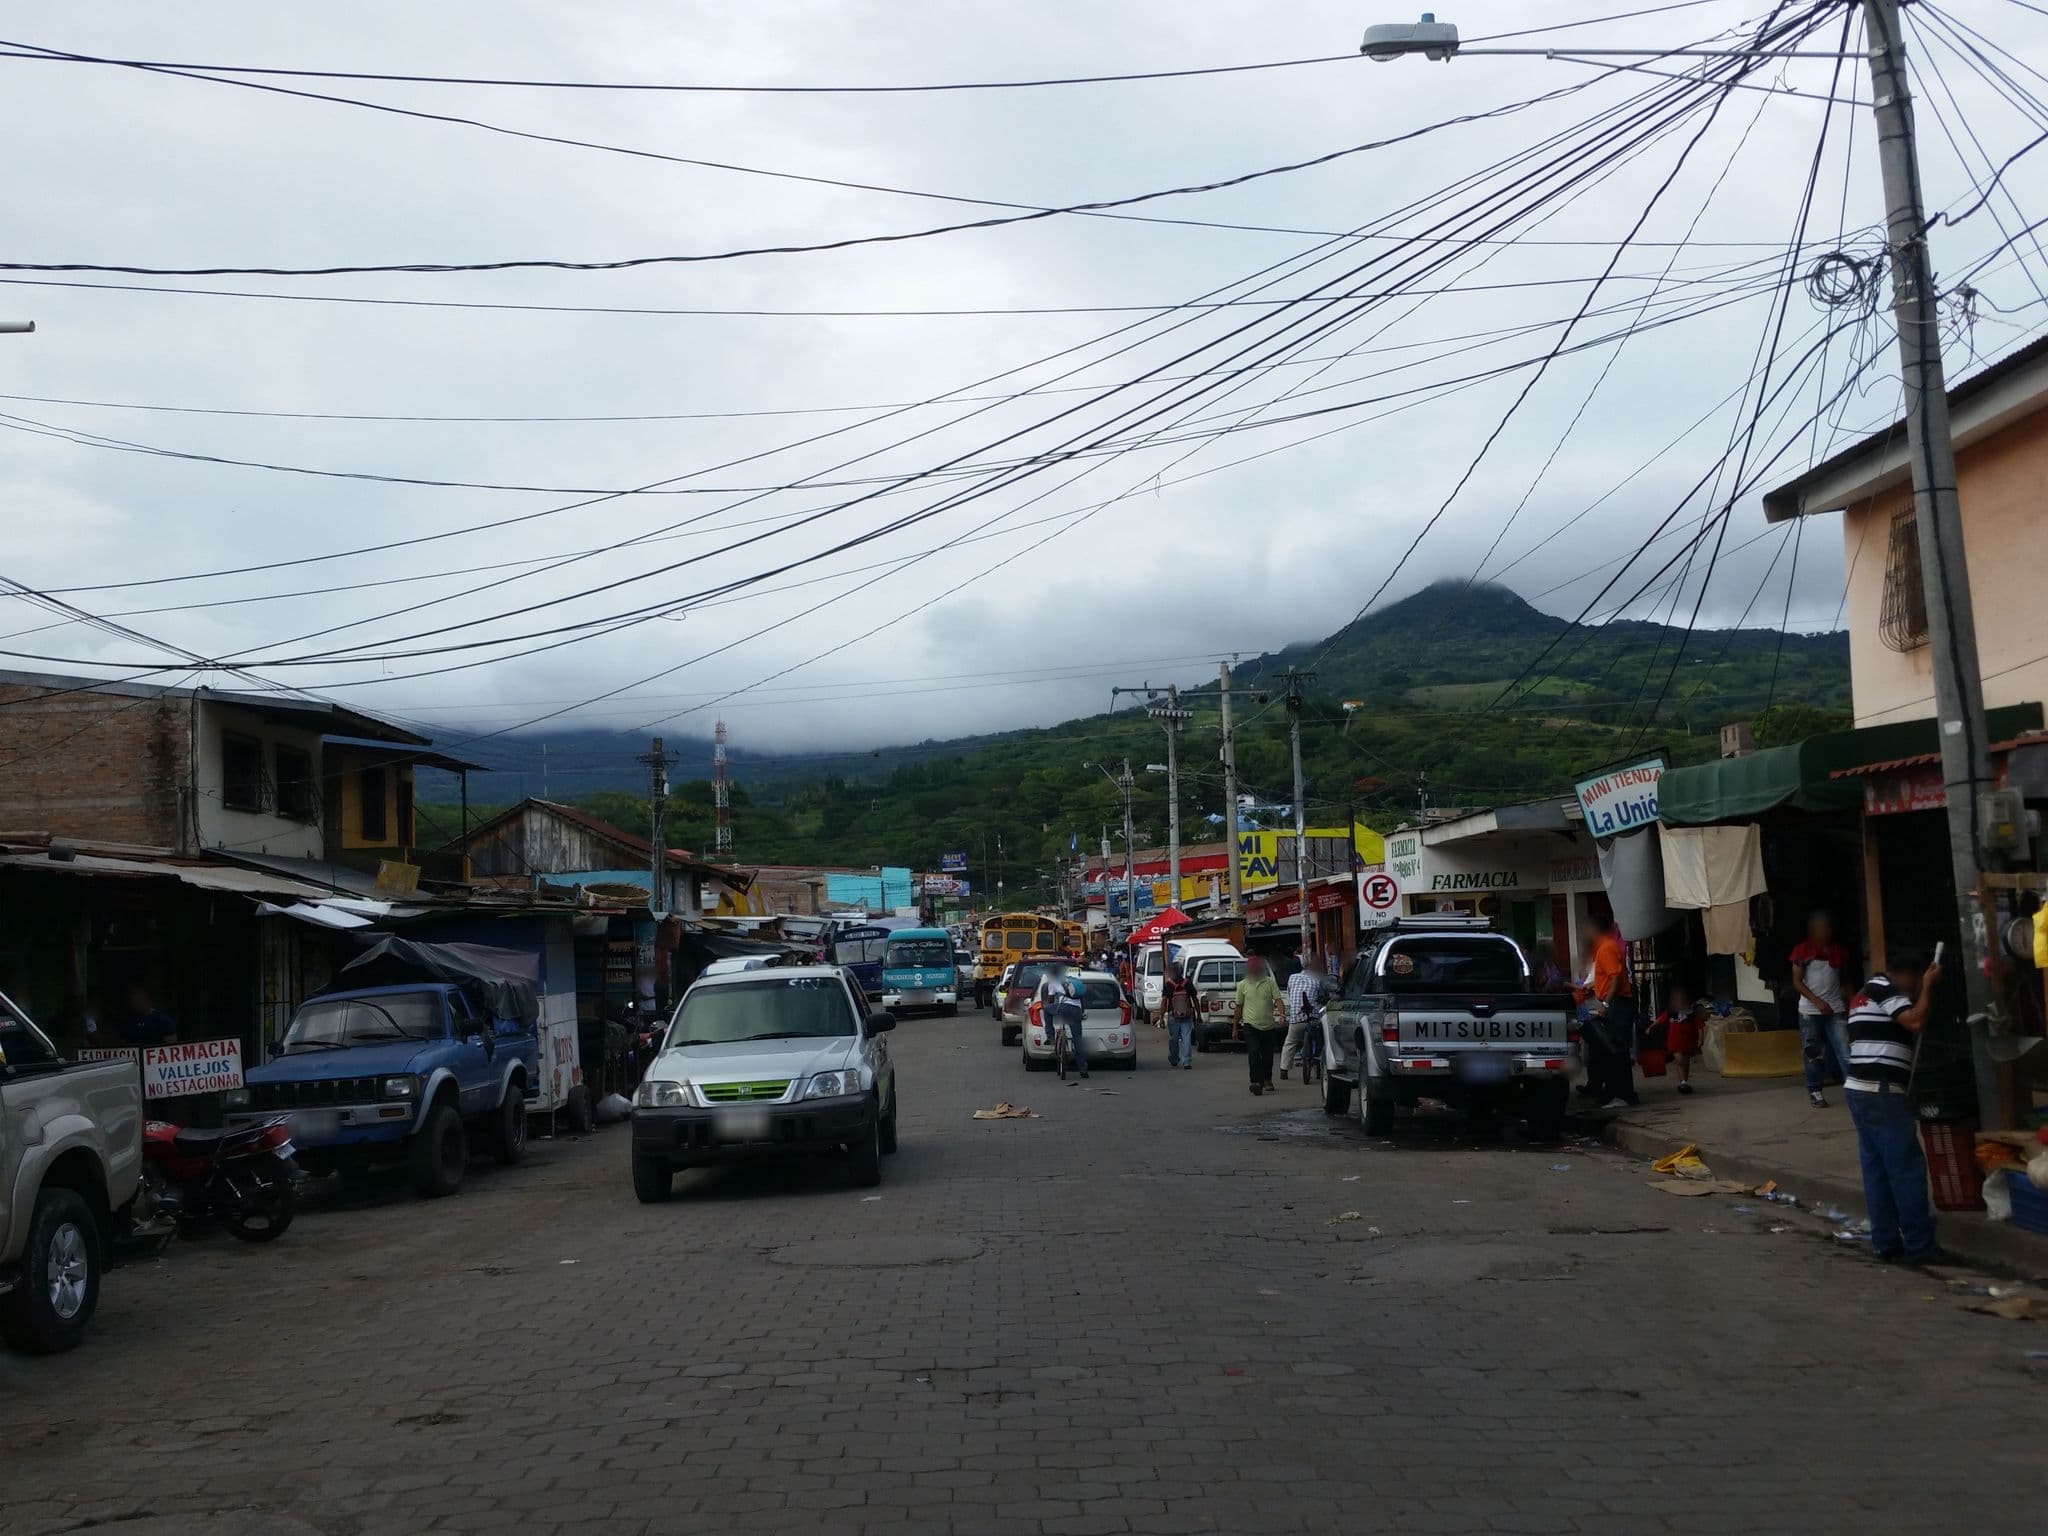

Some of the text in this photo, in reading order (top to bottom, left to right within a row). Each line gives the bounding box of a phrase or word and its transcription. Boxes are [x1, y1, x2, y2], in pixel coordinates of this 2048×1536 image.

[1582, 768, 1661, 808] MINI TIENDA
[1590, 810, 1615, 834] La
[1431, 871, 1519, 891] FARMACIA
[1376, 911, 1387, 919] NO
[1415, 1021, 1553, 1039] MITSUBISHI
[145, 1040, 238, 1066] FARMACIA
[158, 1060, 231, 1081] VALLEJOS
[147, 1073, 240, 1098] NO ESTACIONAR
